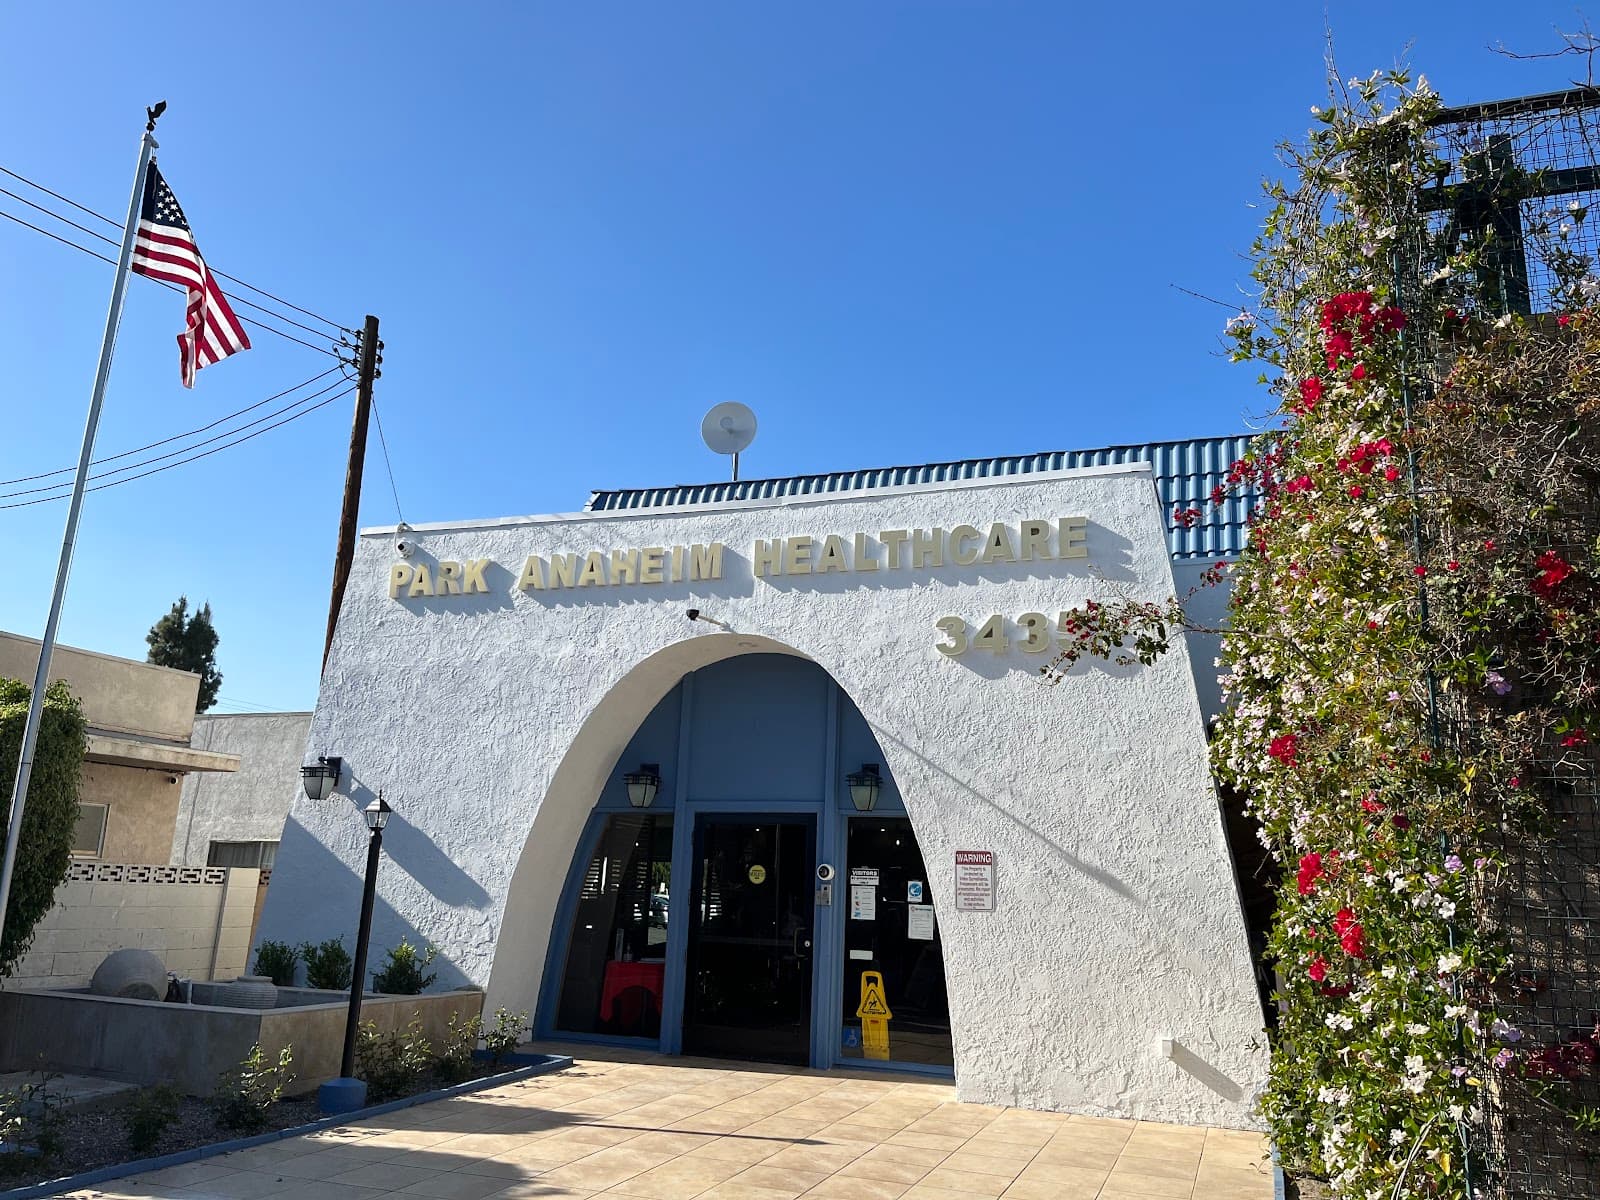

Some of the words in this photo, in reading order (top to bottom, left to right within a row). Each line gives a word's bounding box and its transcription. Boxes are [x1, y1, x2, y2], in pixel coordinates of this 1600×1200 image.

[389, 559, 490, 599] PARK
[518, 543, 723, 591] ANAHEIM
[754, 517, 1089, 577] HEALTHCARE
[956, 853, 992, 863] WARNING
